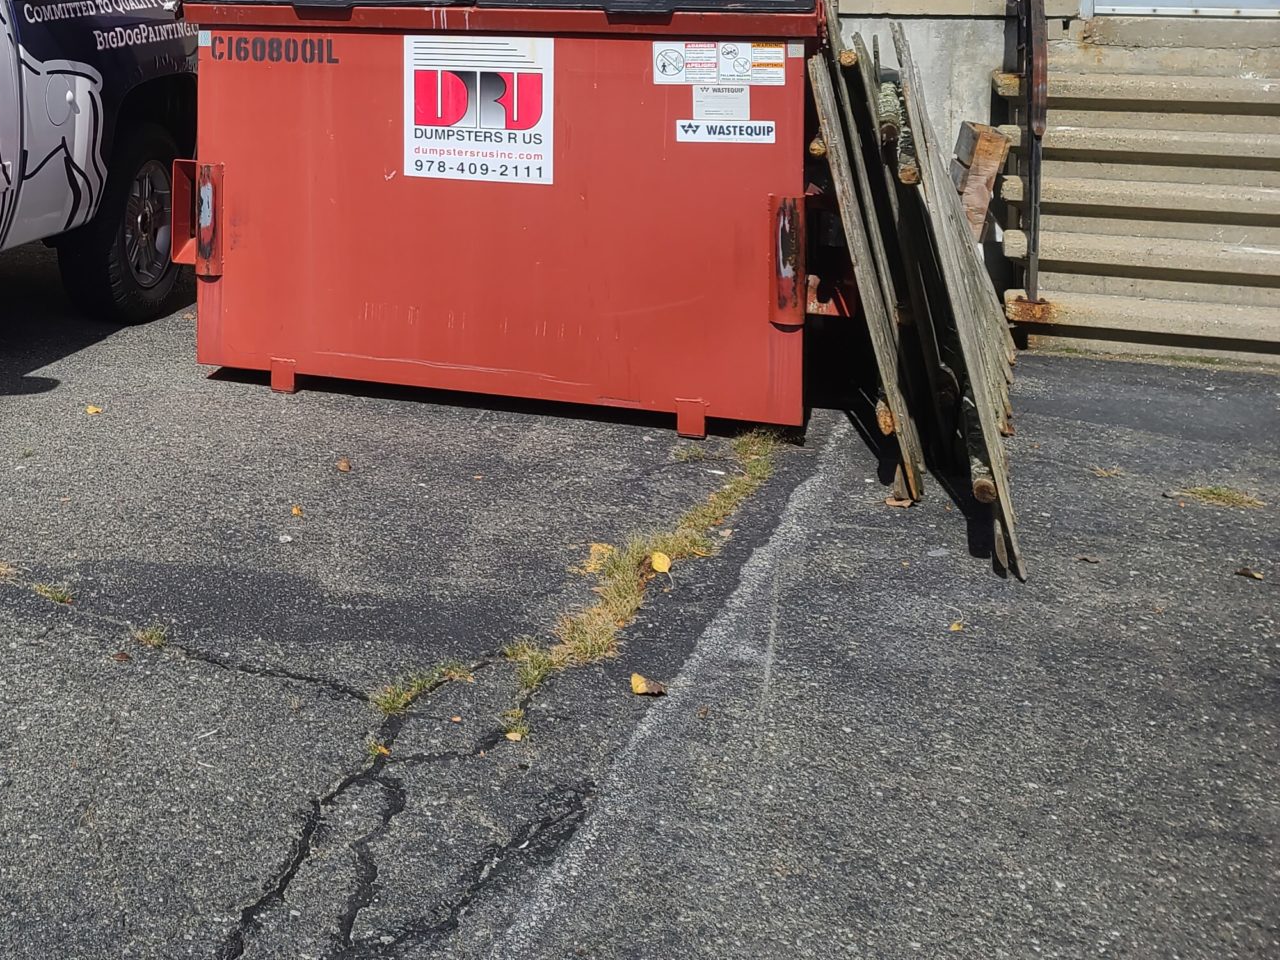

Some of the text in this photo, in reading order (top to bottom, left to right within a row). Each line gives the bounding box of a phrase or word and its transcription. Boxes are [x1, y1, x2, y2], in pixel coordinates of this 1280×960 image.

[23, 3, 96, 24] COMMITTED
[95, 0, 113, 14] TO
[414, 127, 543, 145] DUMPSTERS R US
[706, 124, 774, 137] WASTEQUIP
[414, 145, 543, 161] dumpstersrusinc.com
[414, 159, 543, 178] 978-409-2111
